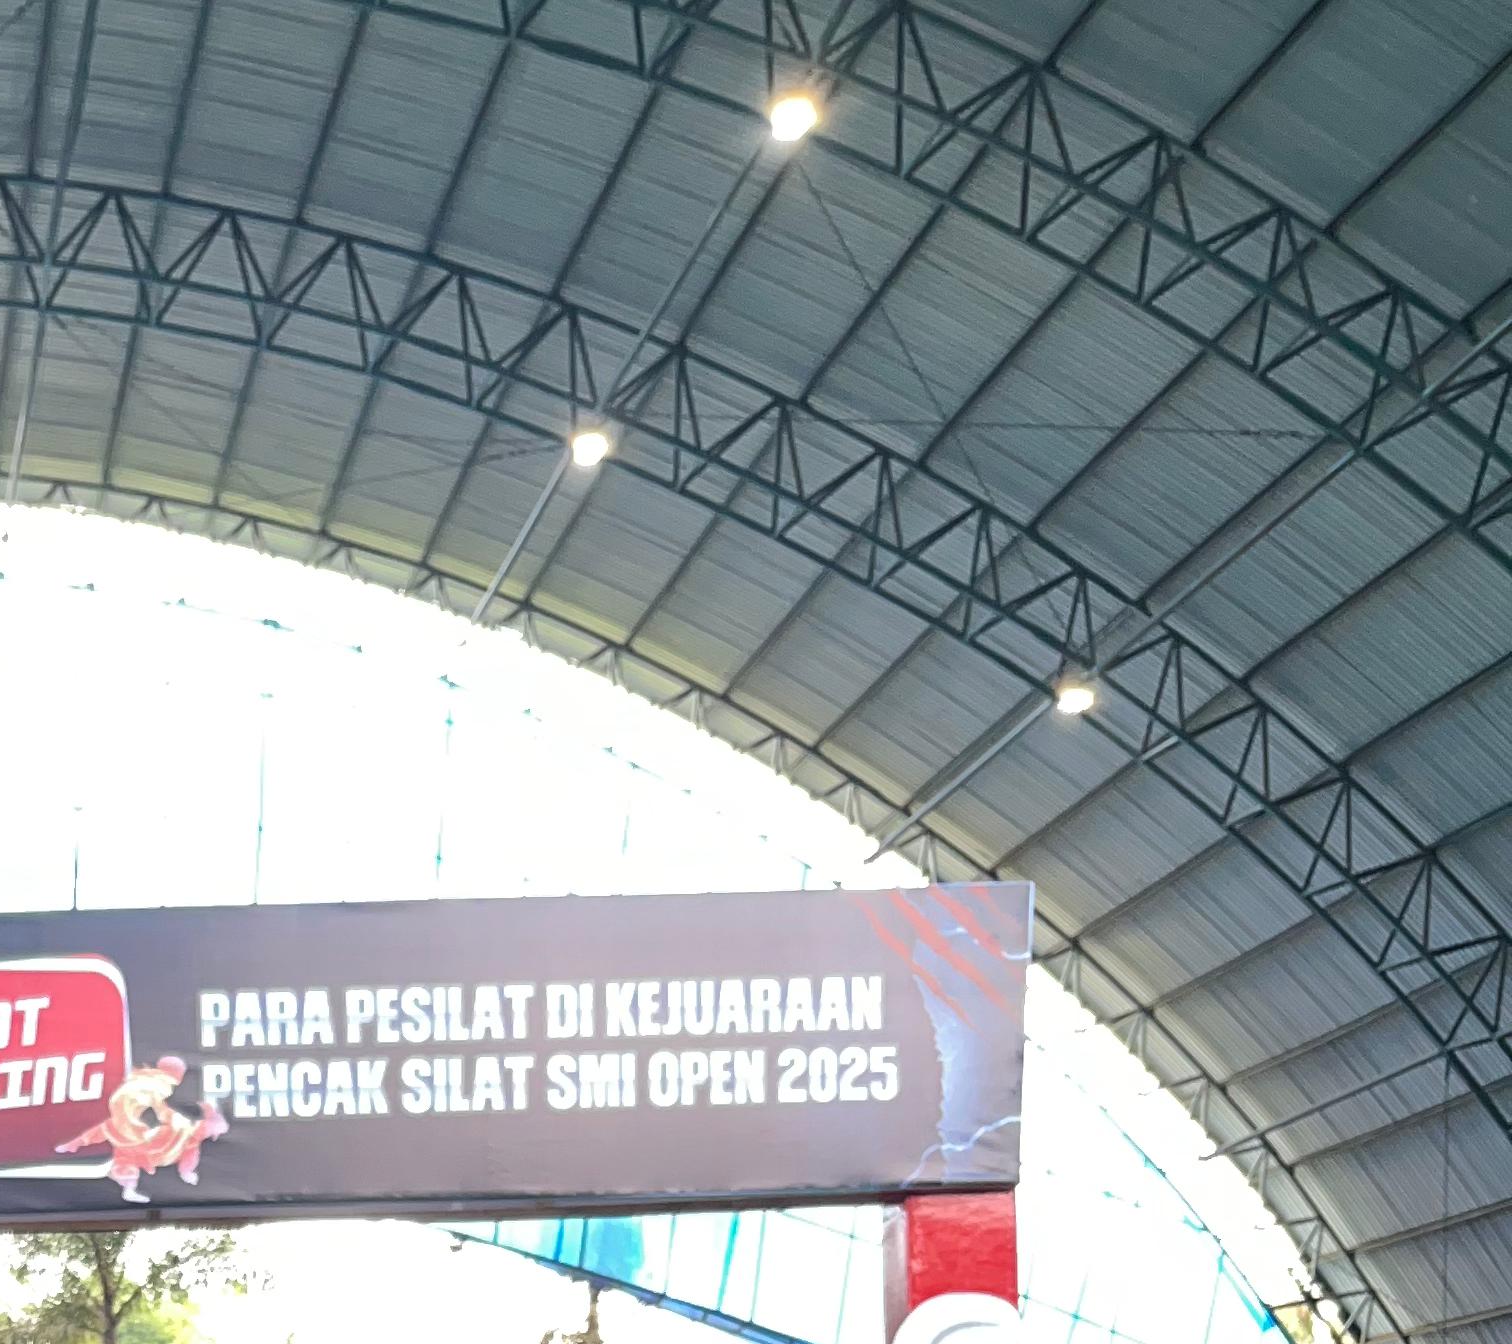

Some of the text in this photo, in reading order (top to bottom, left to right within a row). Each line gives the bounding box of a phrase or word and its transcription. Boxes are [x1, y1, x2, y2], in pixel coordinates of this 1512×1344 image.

[199, 975, 883, 1048] PARA PESILAT DI KEJUARAAN
[202, 1046, 899, 1119] PENCAK SILAT SMI OPEN 2025
